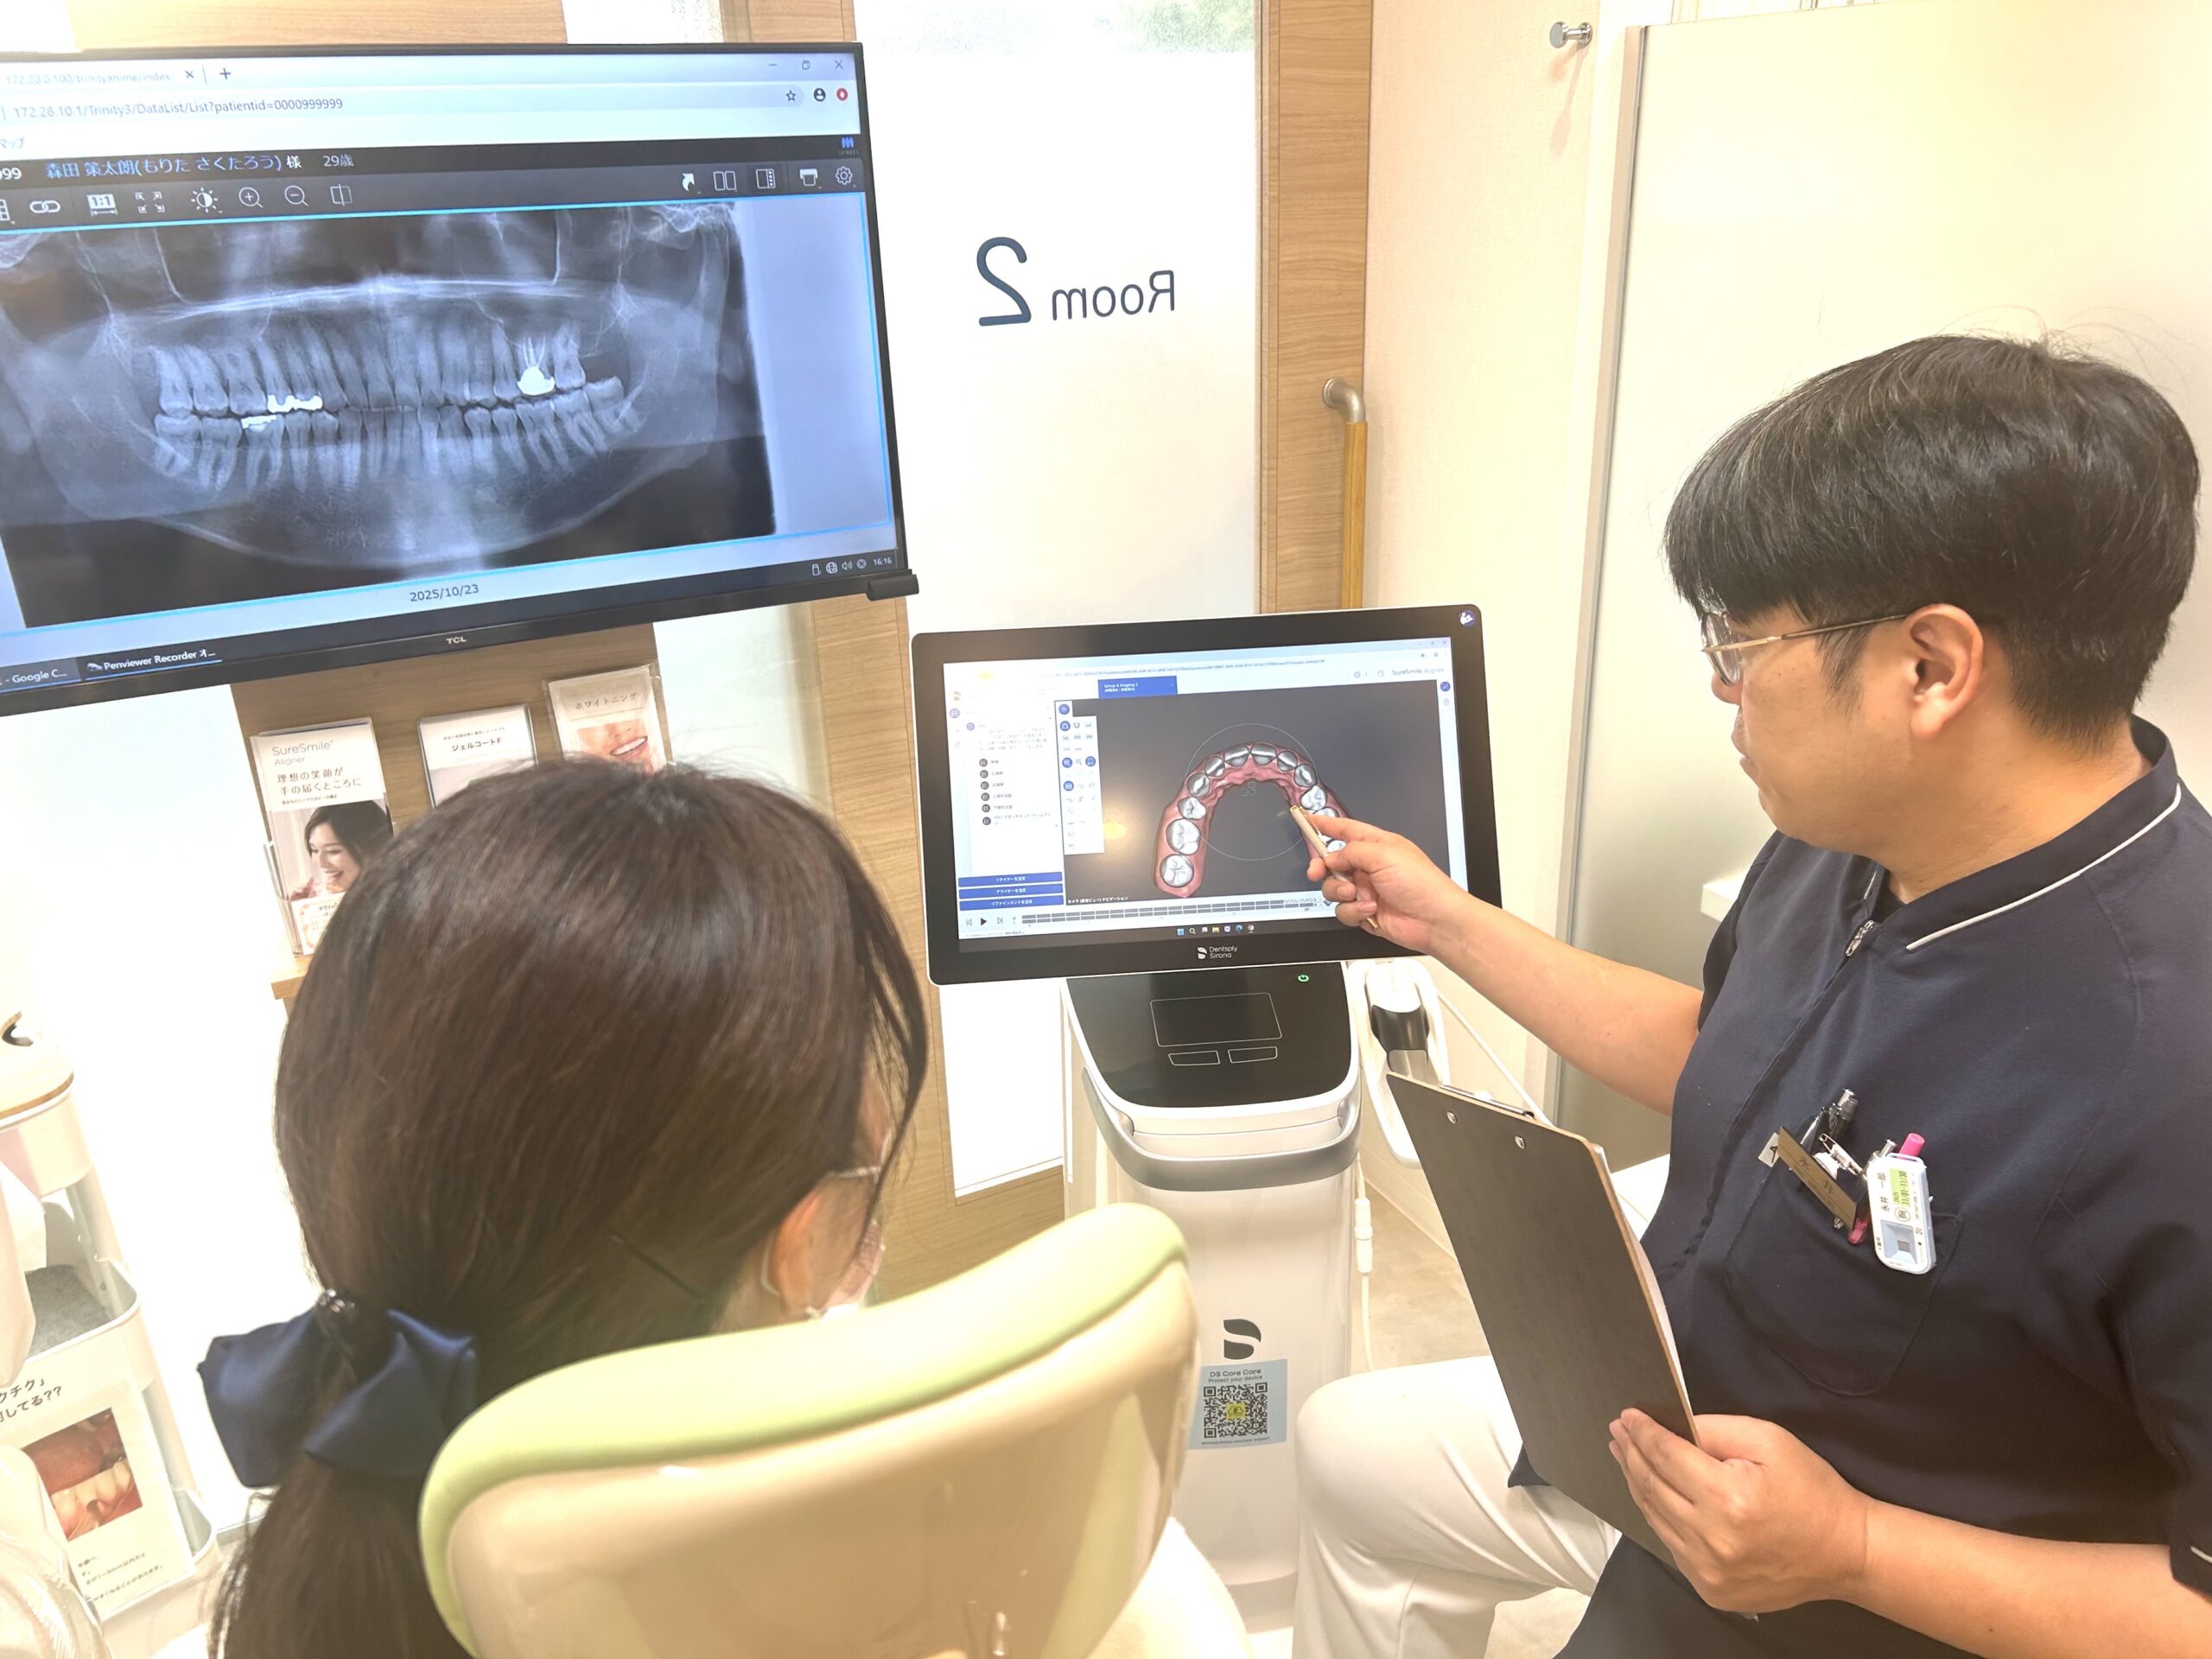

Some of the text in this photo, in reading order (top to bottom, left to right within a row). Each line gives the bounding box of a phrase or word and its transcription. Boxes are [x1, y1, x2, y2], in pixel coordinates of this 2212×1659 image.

[0, 167, 22, 180] 99
[45, 162, 79, 179] 森田
[873, 556, 892, 566] 16:16
[410, 584, 480, 601] 2025/10/23
[446, 636, 467, 645] TCL
[11, 671, 49, 684] Google
[104, 658, 152, 671] Penviewer
[155, 650, 197, 664] Recorder
[575, 691, 637, 709] ホワイトニング
[452, 737, 502, 751] ジェルコートF
[274, 757, 306, 766] Aligner
[276, 766, 344, 784] 理想の笑顔が
[280, 778, 362, 796] 手の届くところに
[1209, 944, 1237, 953] Dentsply
